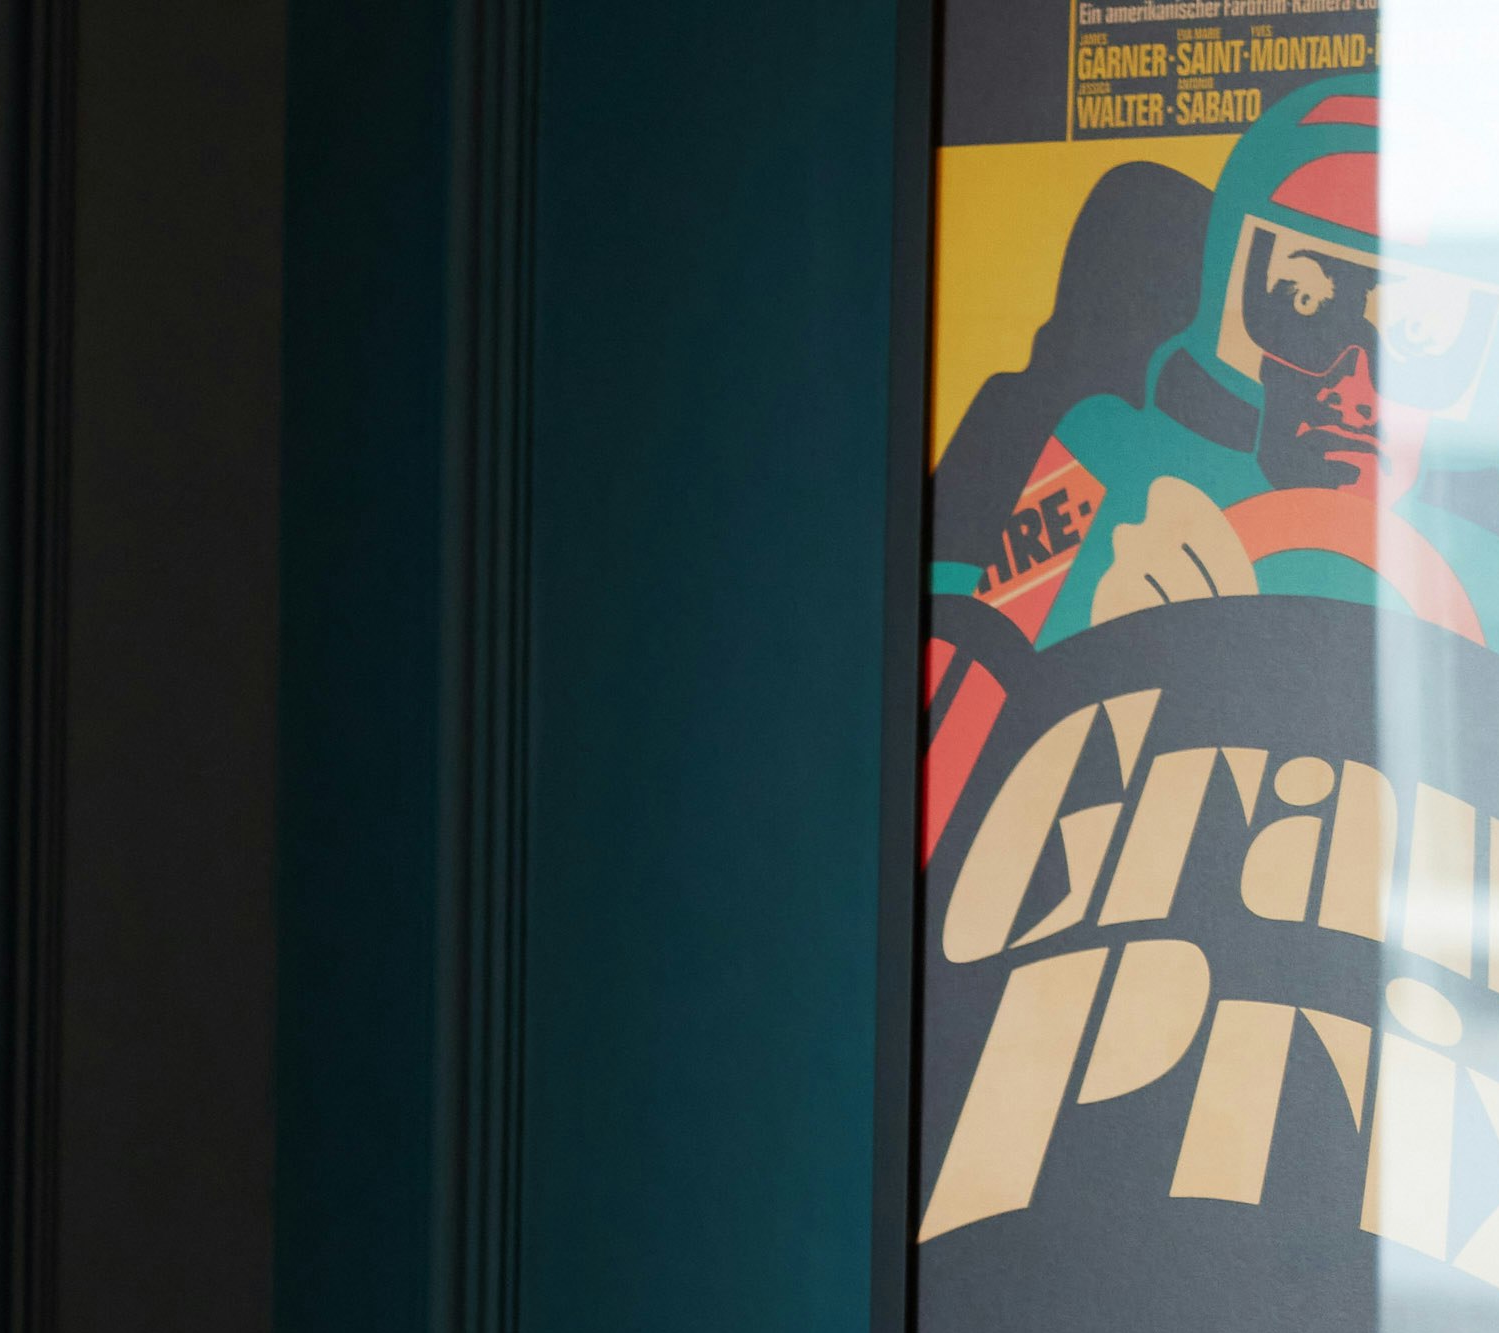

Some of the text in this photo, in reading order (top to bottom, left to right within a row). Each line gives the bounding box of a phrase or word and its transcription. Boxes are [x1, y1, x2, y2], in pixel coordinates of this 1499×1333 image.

[1079, 2, 1101, 25] Ein
[1076, 88, 1261, 130] WALTER SABATO
